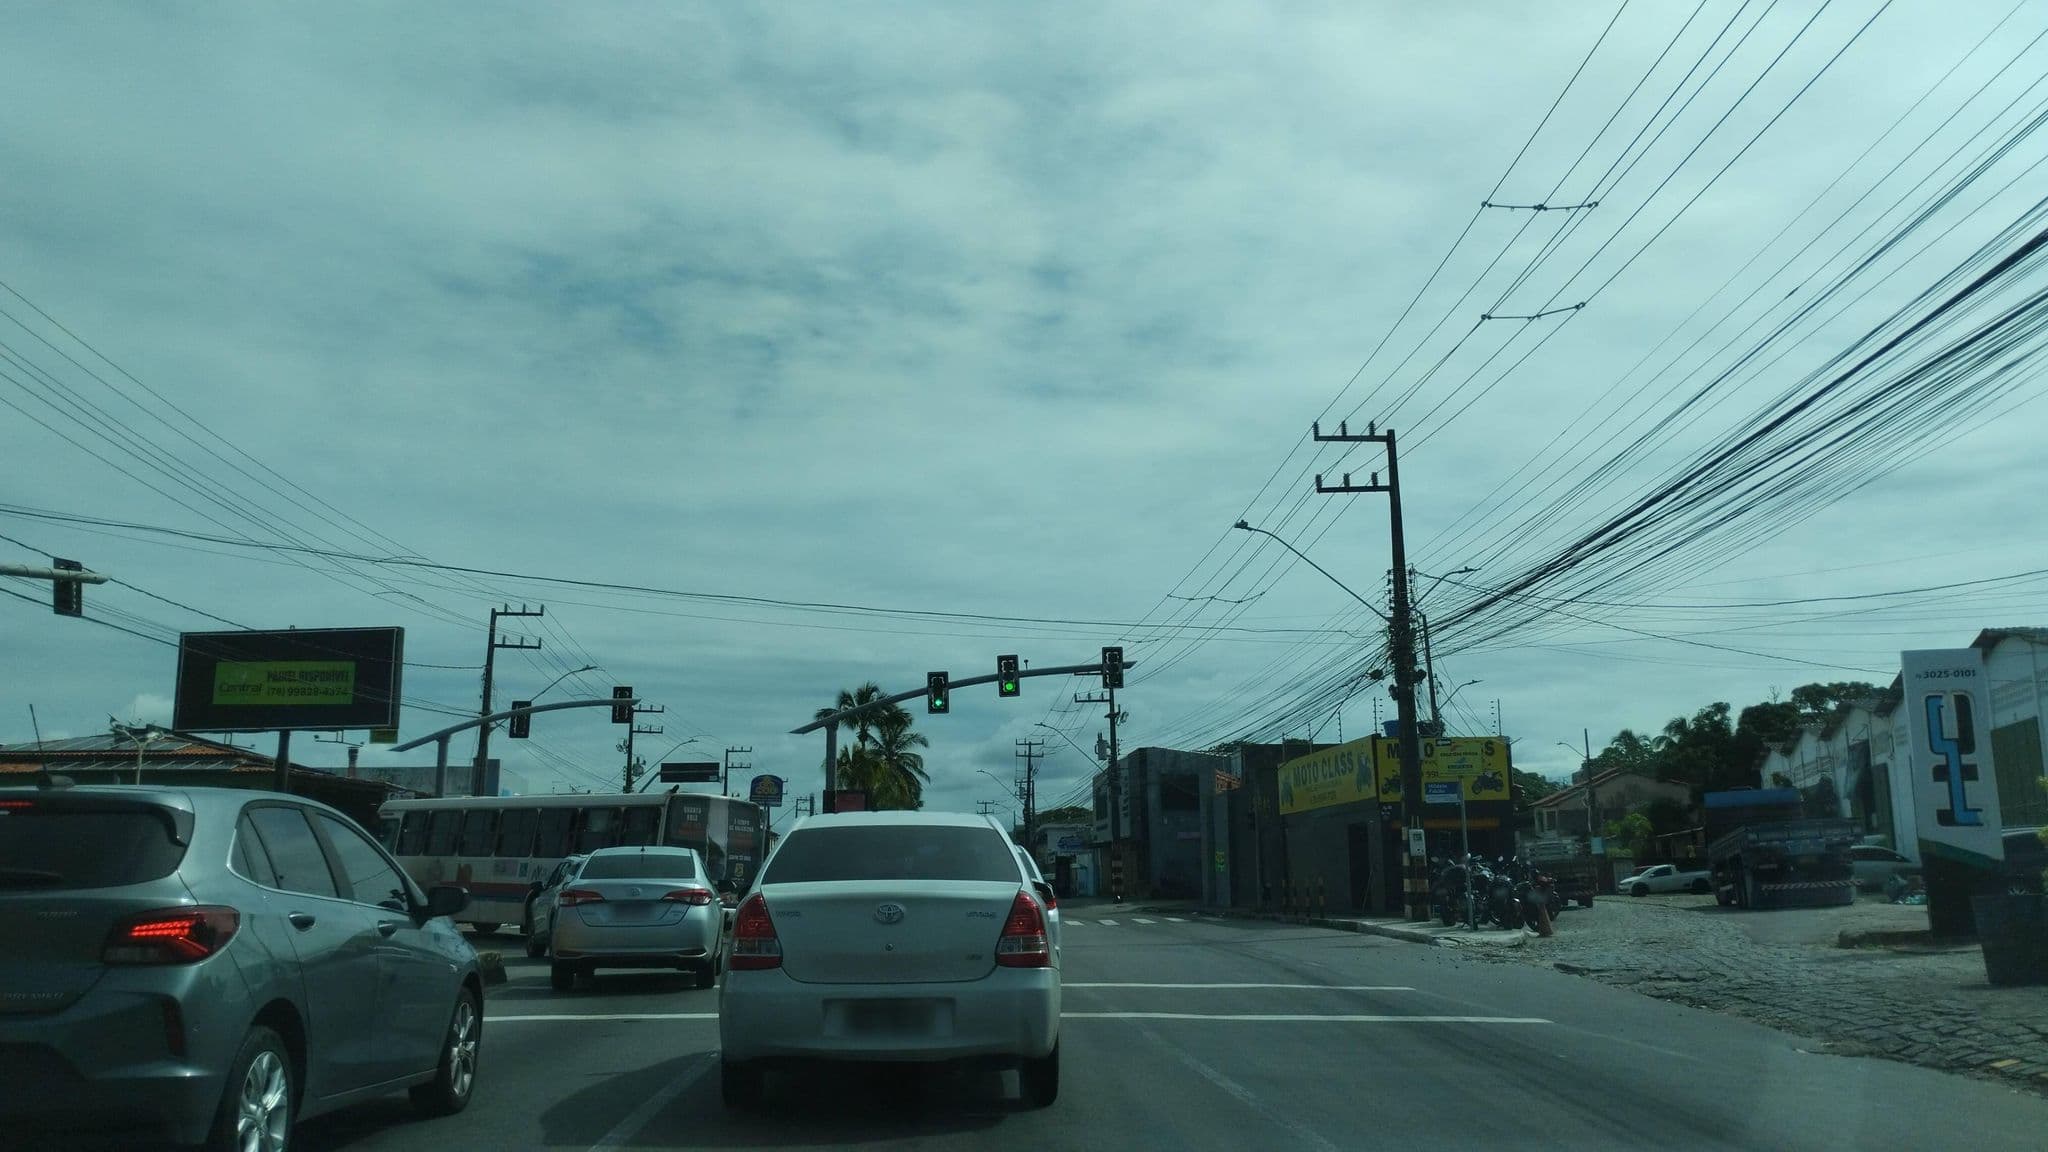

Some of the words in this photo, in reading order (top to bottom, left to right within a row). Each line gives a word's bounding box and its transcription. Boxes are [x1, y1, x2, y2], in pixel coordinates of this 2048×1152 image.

[1923, 669, 1976, 679] 3025-0101
[218, 681, 262, 694] Central
[1294, 761, 1319, 785] MOTO
[1322, 752, 1354, 779] CLASS
